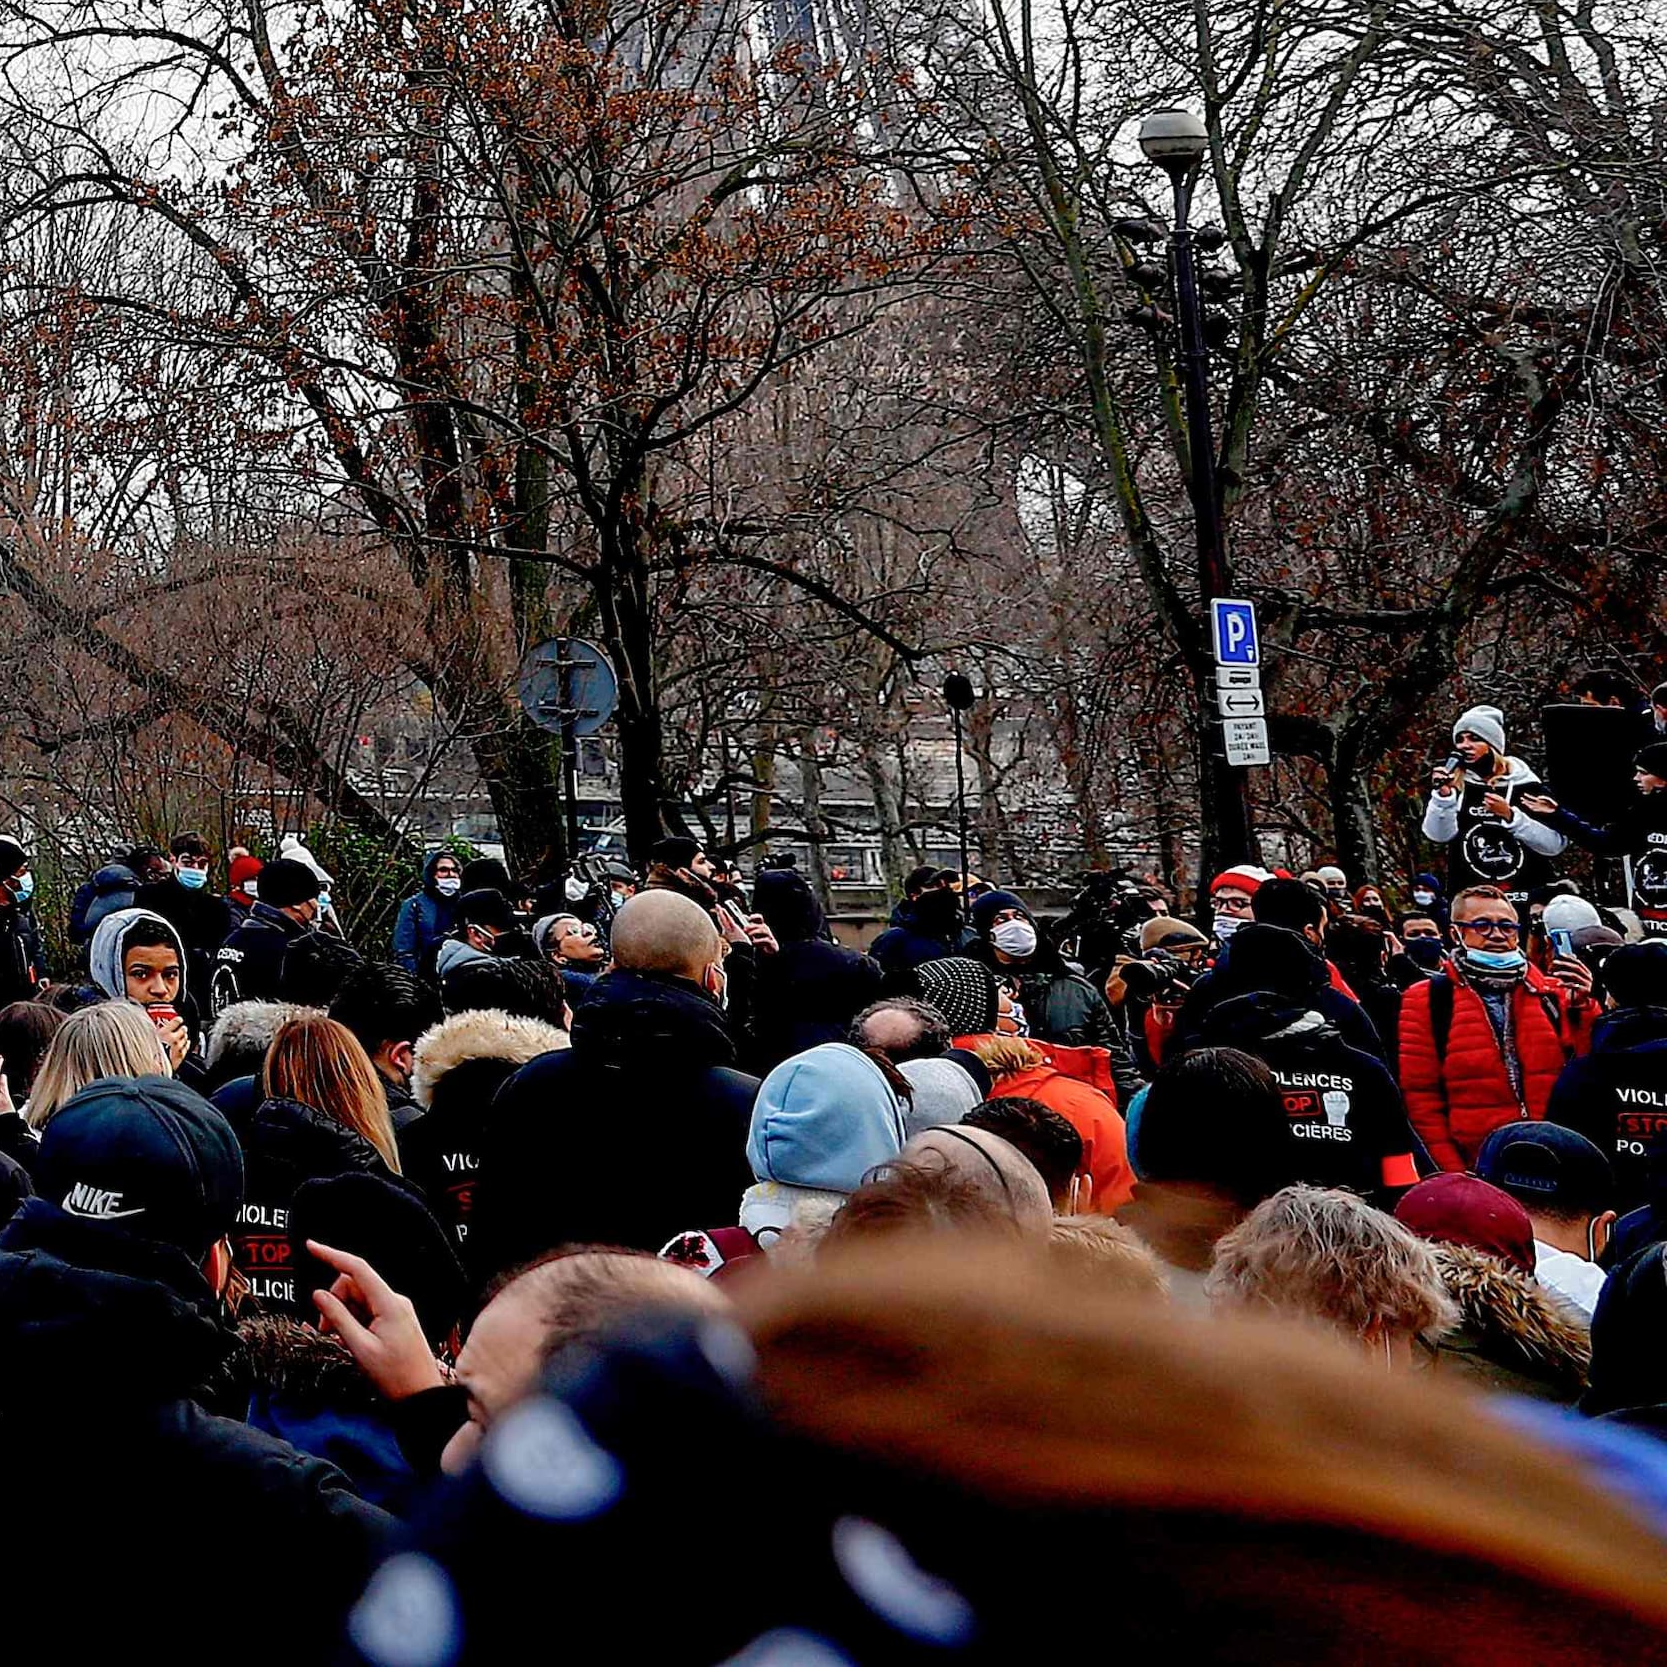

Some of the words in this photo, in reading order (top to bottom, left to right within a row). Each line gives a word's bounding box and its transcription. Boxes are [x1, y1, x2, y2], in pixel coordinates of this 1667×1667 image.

[1226, 611, 1245, 653] P
[1288, 1120, 1353, 1142] CIÈRES
[70, 1181, 124, 1215] NIKE
[243, 1242, 292, 1264] TOP
